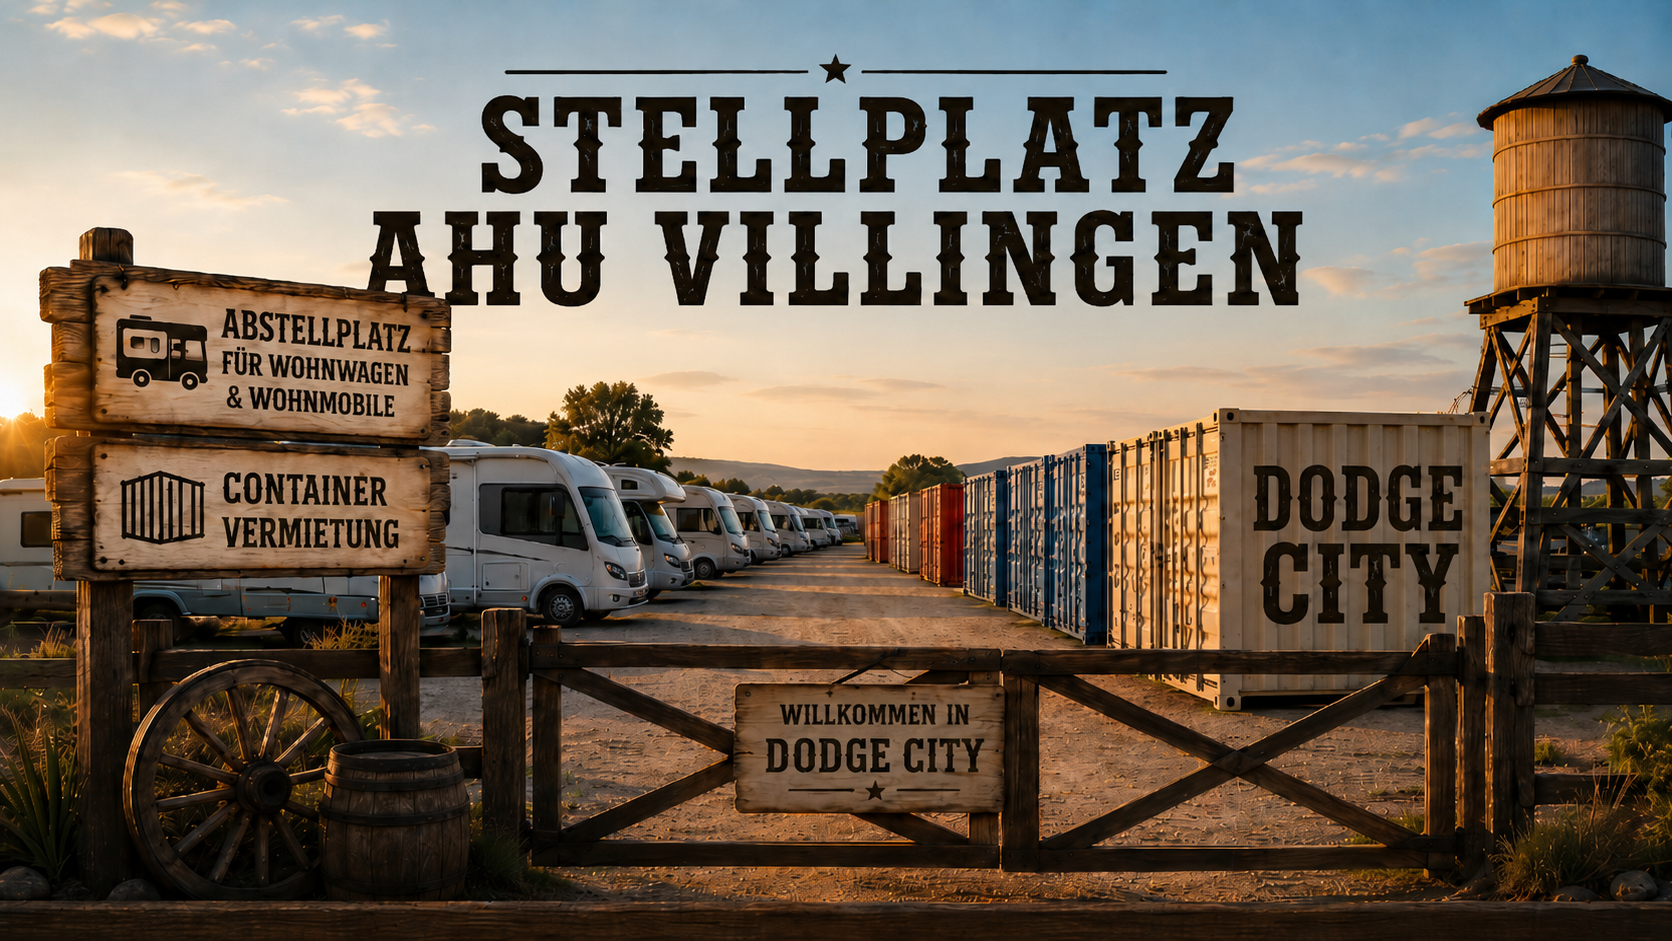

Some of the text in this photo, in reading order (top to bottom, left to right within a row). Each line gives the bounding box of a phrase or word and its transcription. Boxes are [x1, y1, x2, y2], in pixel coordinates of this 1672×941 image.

[221, 308, 412, 354] ABSTELLPLATZ
[222, 346, 409, 386] FÜR WOHNWAGEN
[226, 386, 395, 418] & WOHNMOBILE
[223, 471, 388, 506] CONTAINER
[1253, 464, 1464, 531] DODGE
[222, 516, 400, 549] VERMIETUNG
[1260, 541, 1460, 625] CITY
[780, 703, 970, 725] WILLKOMMEN IN
[765, 738, 985, 773] DODGE CITY
